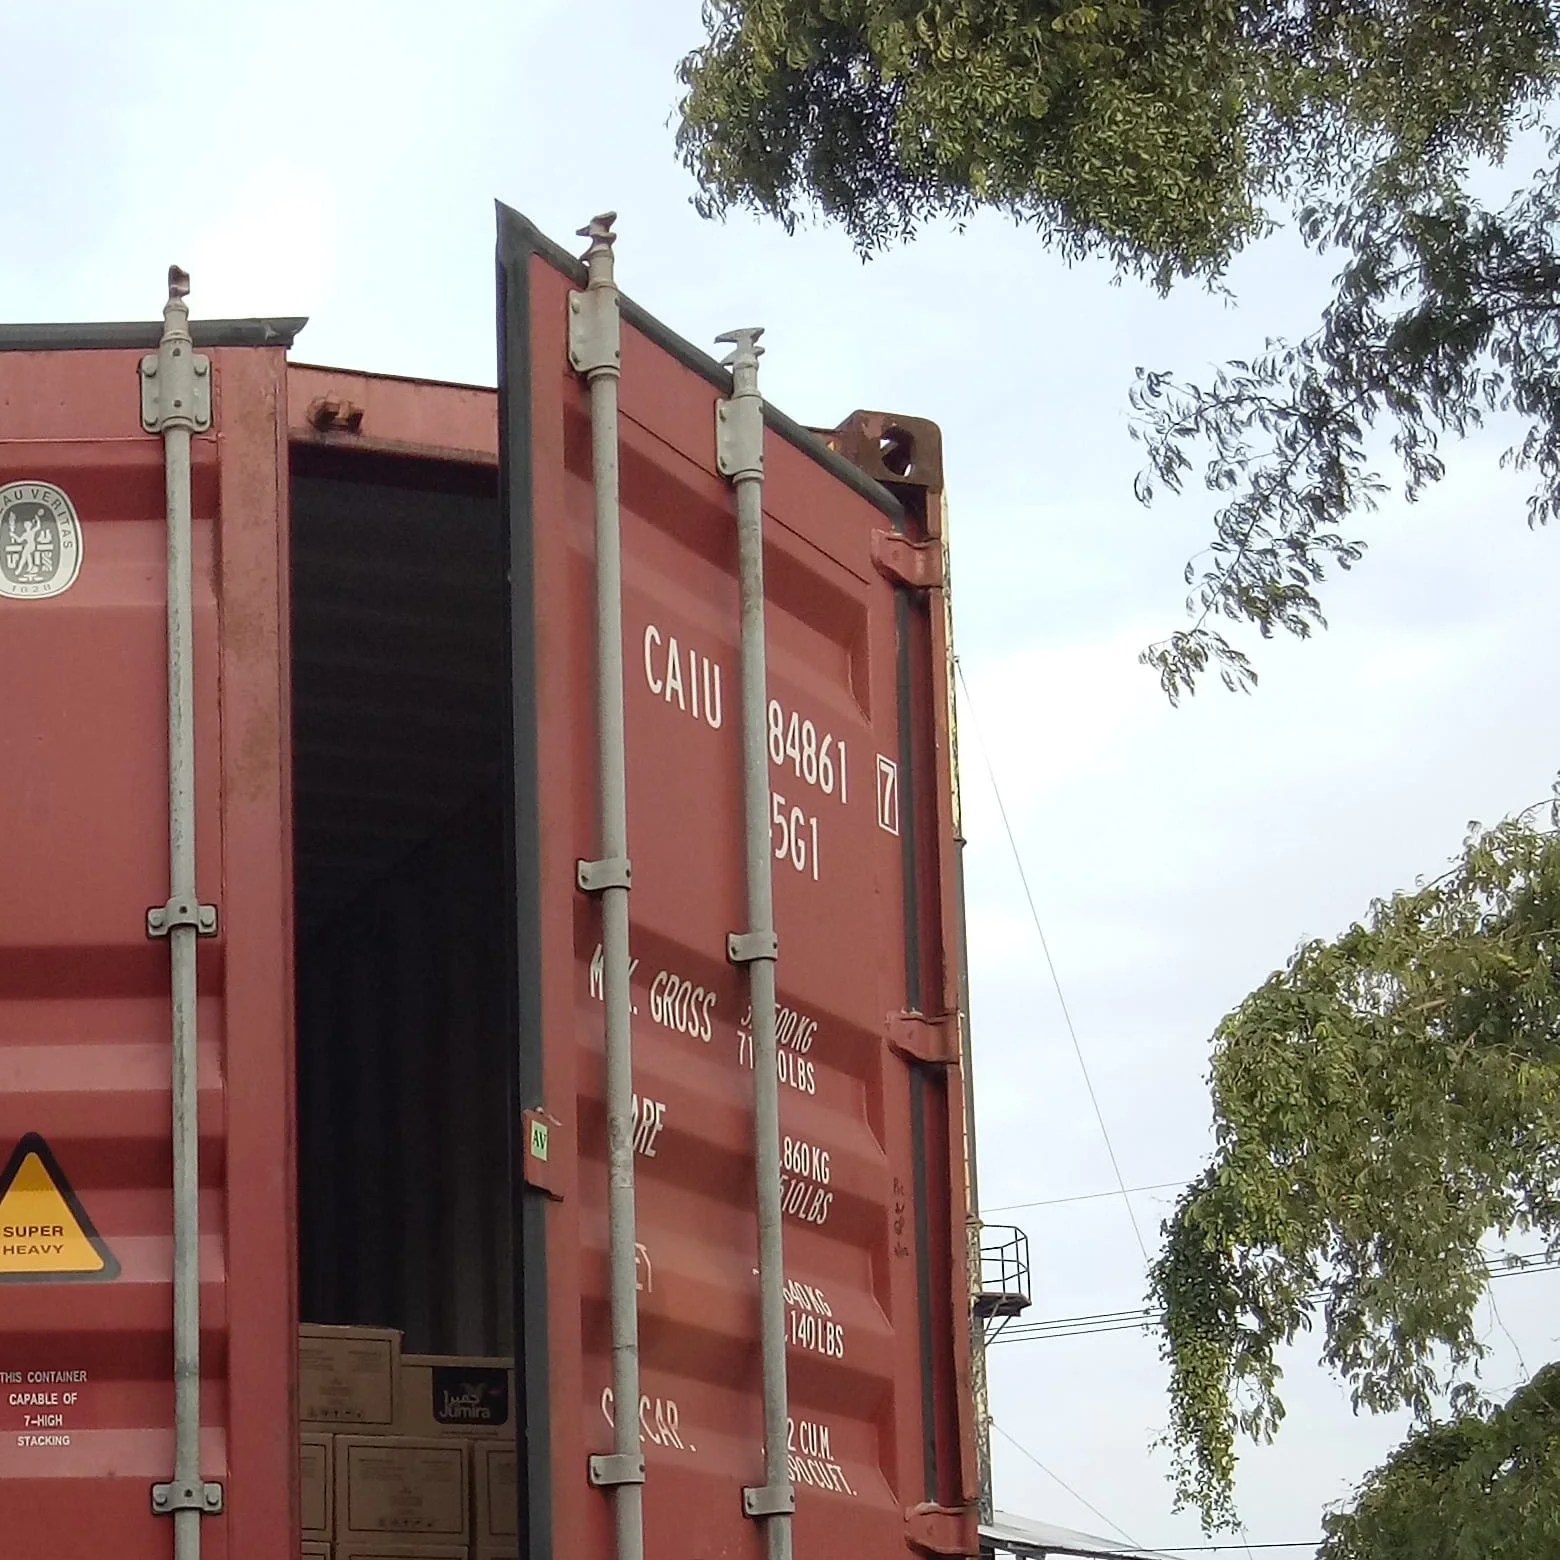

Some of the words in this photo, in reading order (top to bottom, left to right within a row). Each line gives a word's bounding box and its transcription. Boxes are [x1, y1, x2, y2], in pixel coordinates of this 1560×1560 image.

[31, 488, 73, 550] VERITAS
[644, 624, 722, 728] CAIU
[768, 700, 846, 804] 84861
[879, 759, 896, 828] 7
[772, 792, 818, 880] 5G1
[650, 971, 716, 1042] GROSS
[2, 1225, 64, 1238] SUPER
[2, 1244, 64, 1255] HEAVY
[0, 1371, 22, 1384] THIS
[27, 1370, 87, 1384] CONTAINER
[9, 1393, 58, 1405] CAPABLE
[63, 1393, 77, 1405] OF
[24, 1414, 63, 1427] 7-HIGH
[17, 1435, 70, 1447] STACKING
